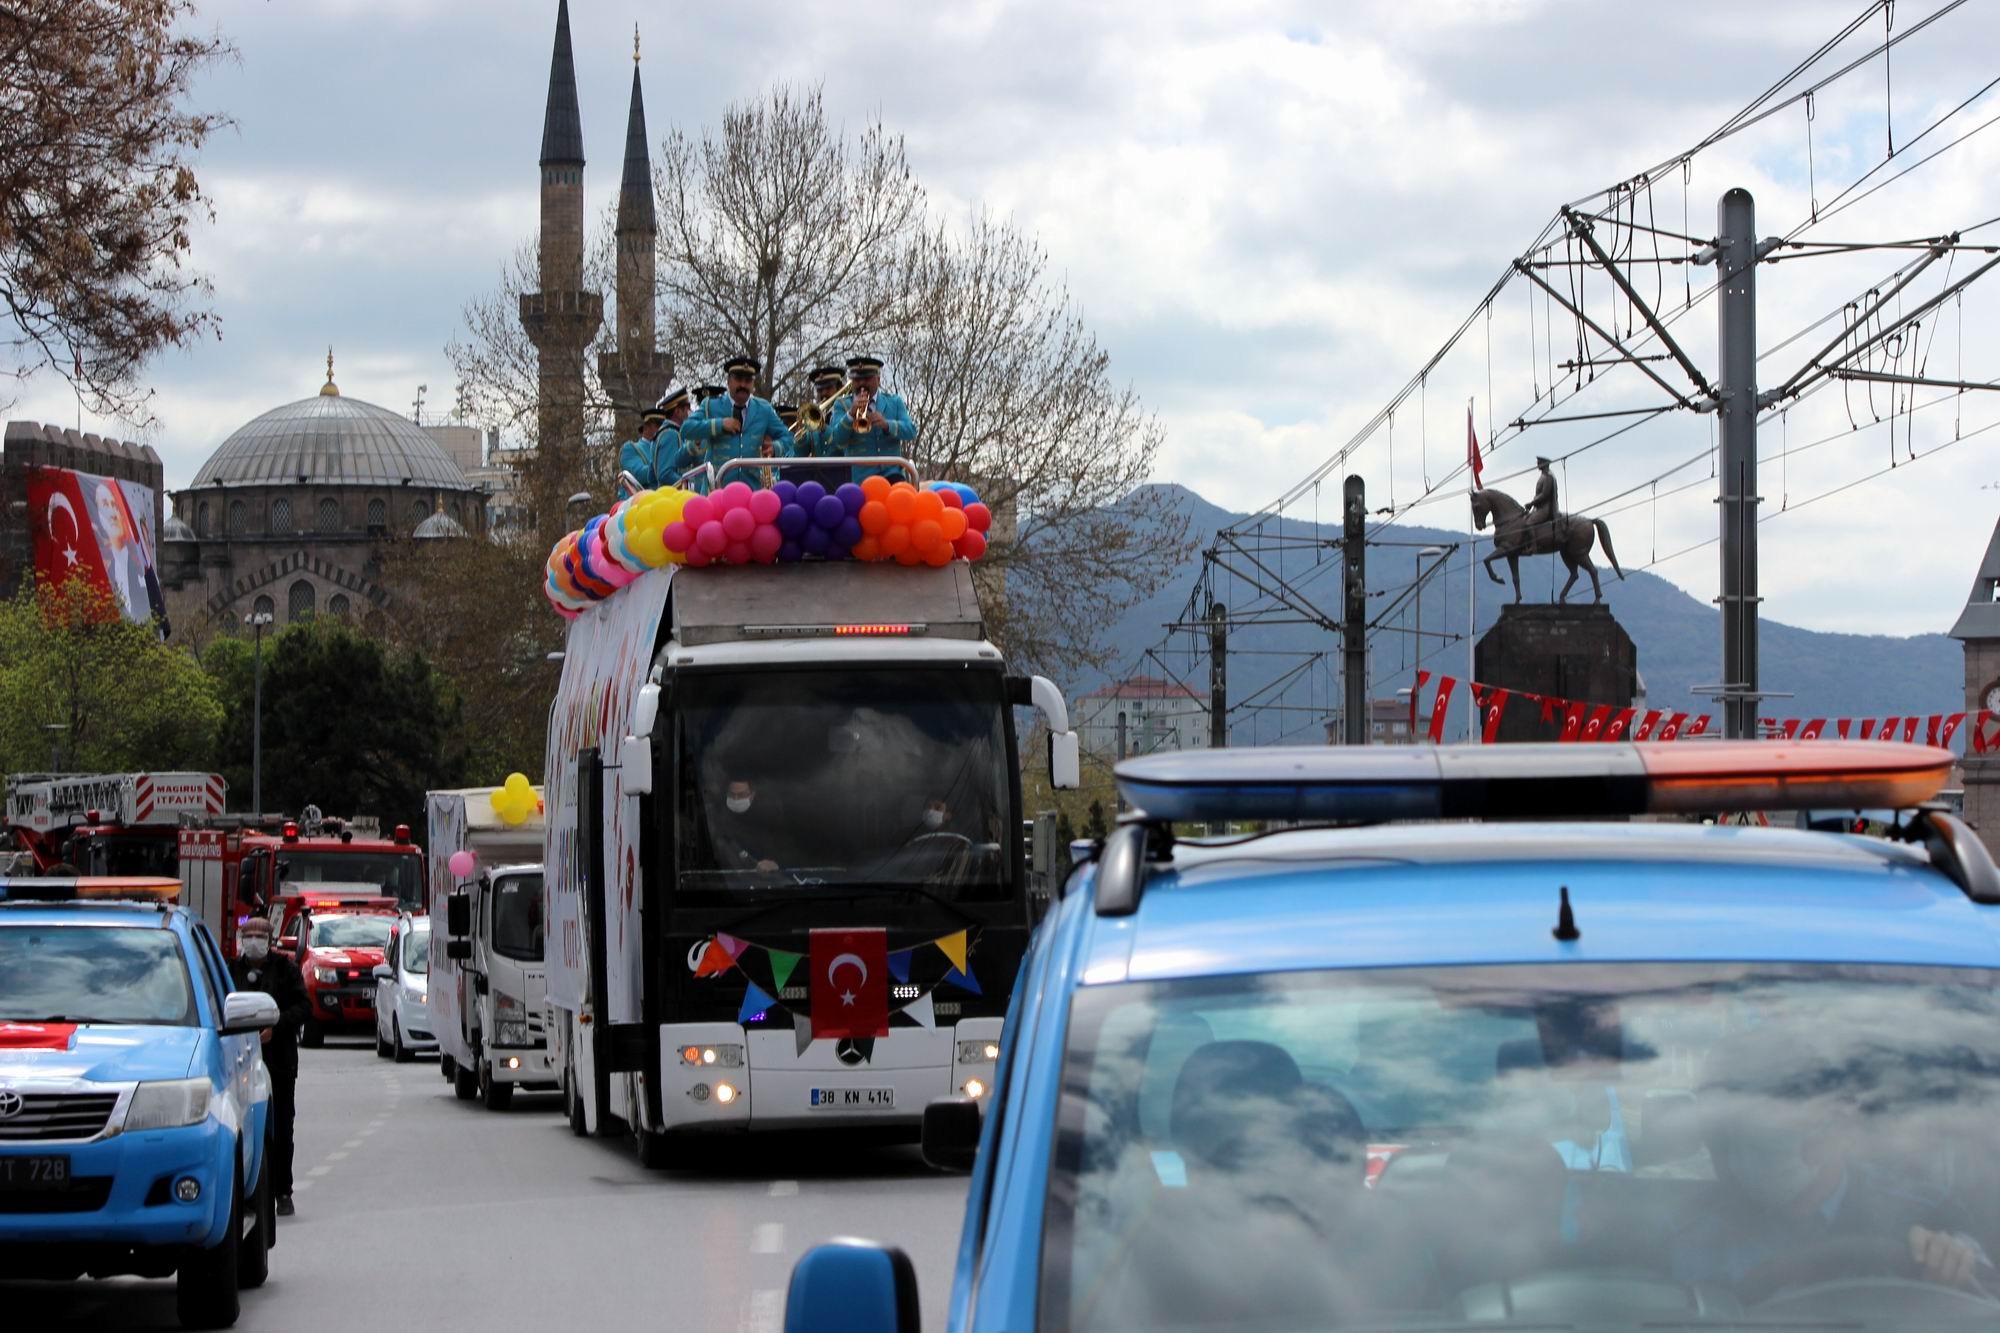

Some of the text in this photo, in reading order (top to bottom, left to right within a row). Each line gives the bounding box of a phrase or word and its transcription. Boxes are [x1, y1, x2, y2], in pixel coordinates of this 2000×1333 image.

[156, 785, 203, 793] MAGIRUS
[820, 1090, 890, 1104] 38 KN 414
[29, 1159, 65, 1181] 728
